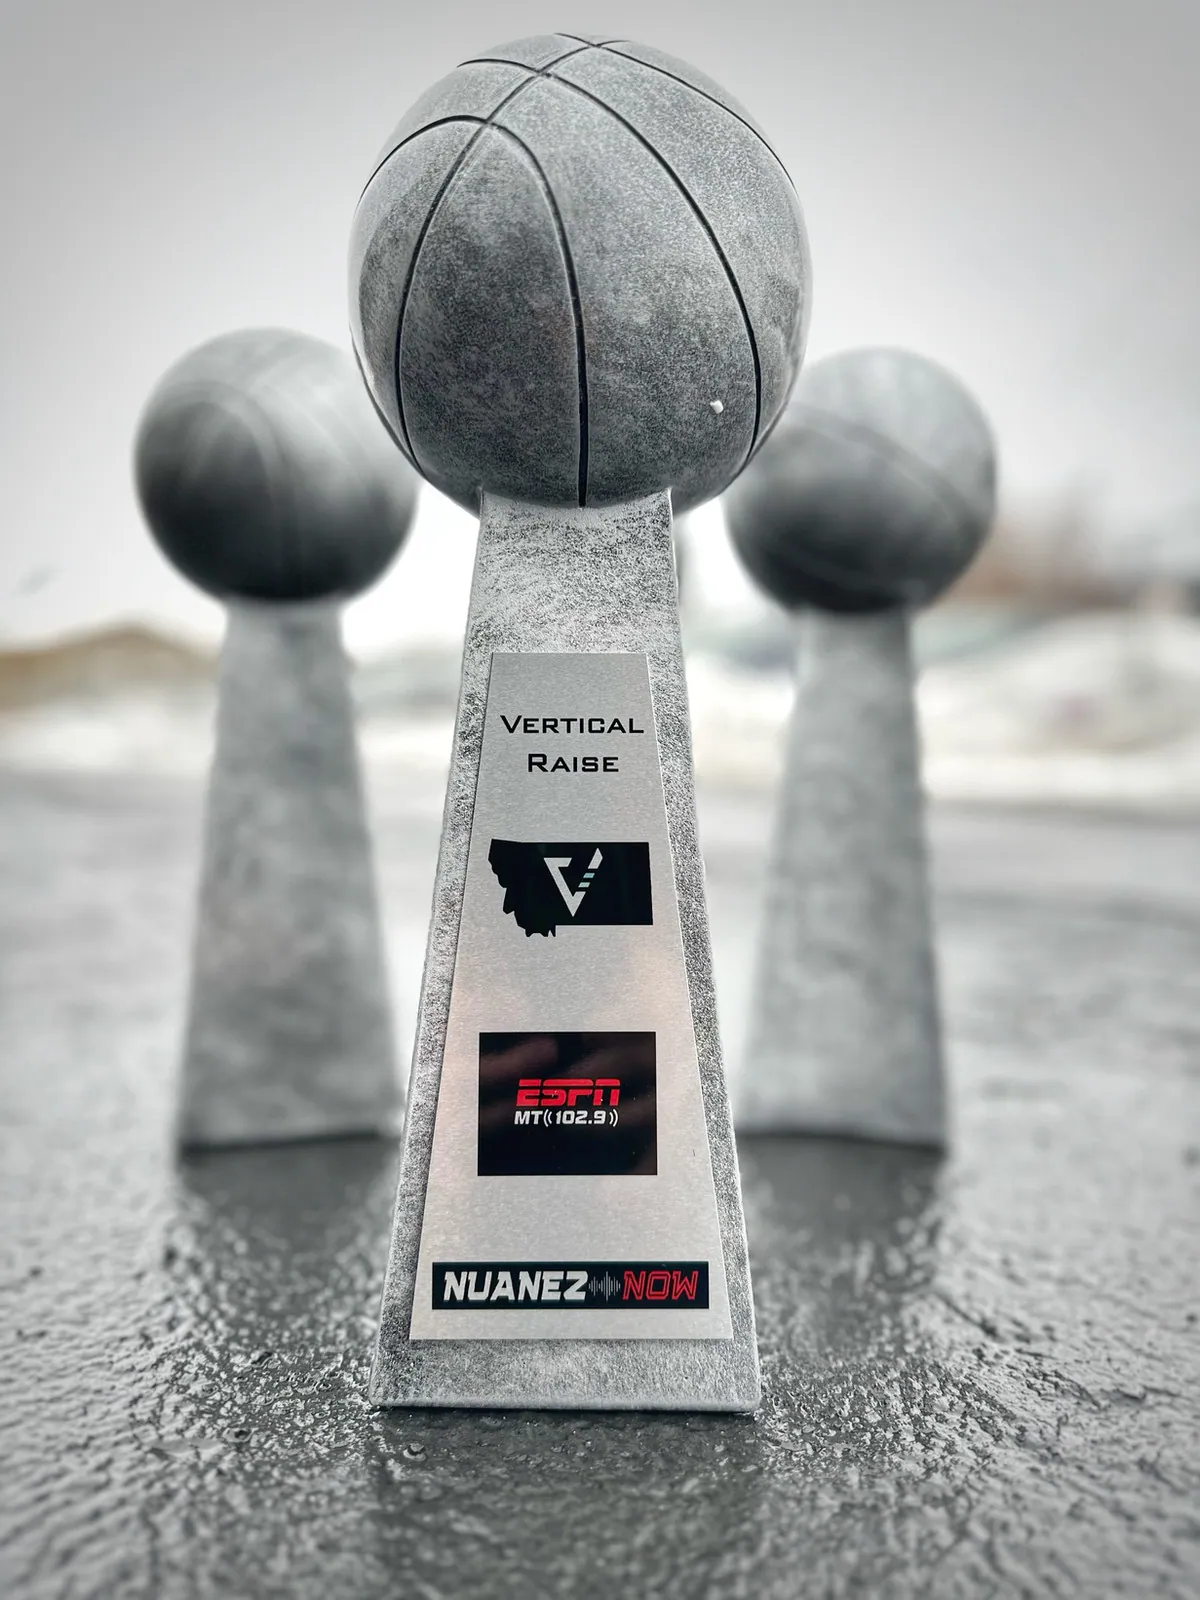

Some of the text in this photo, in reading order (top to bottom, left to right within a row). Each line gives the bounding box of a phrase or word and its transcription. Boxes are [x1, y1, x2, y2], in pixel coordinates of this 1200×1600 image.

[500, 715, 645, 734] VERTICAL
[527, 753, 619, 773] RAISE
[516, 1078, 621, 1107] ESPN
[443, 1270, 699, 1301] NUANEZ NOW
